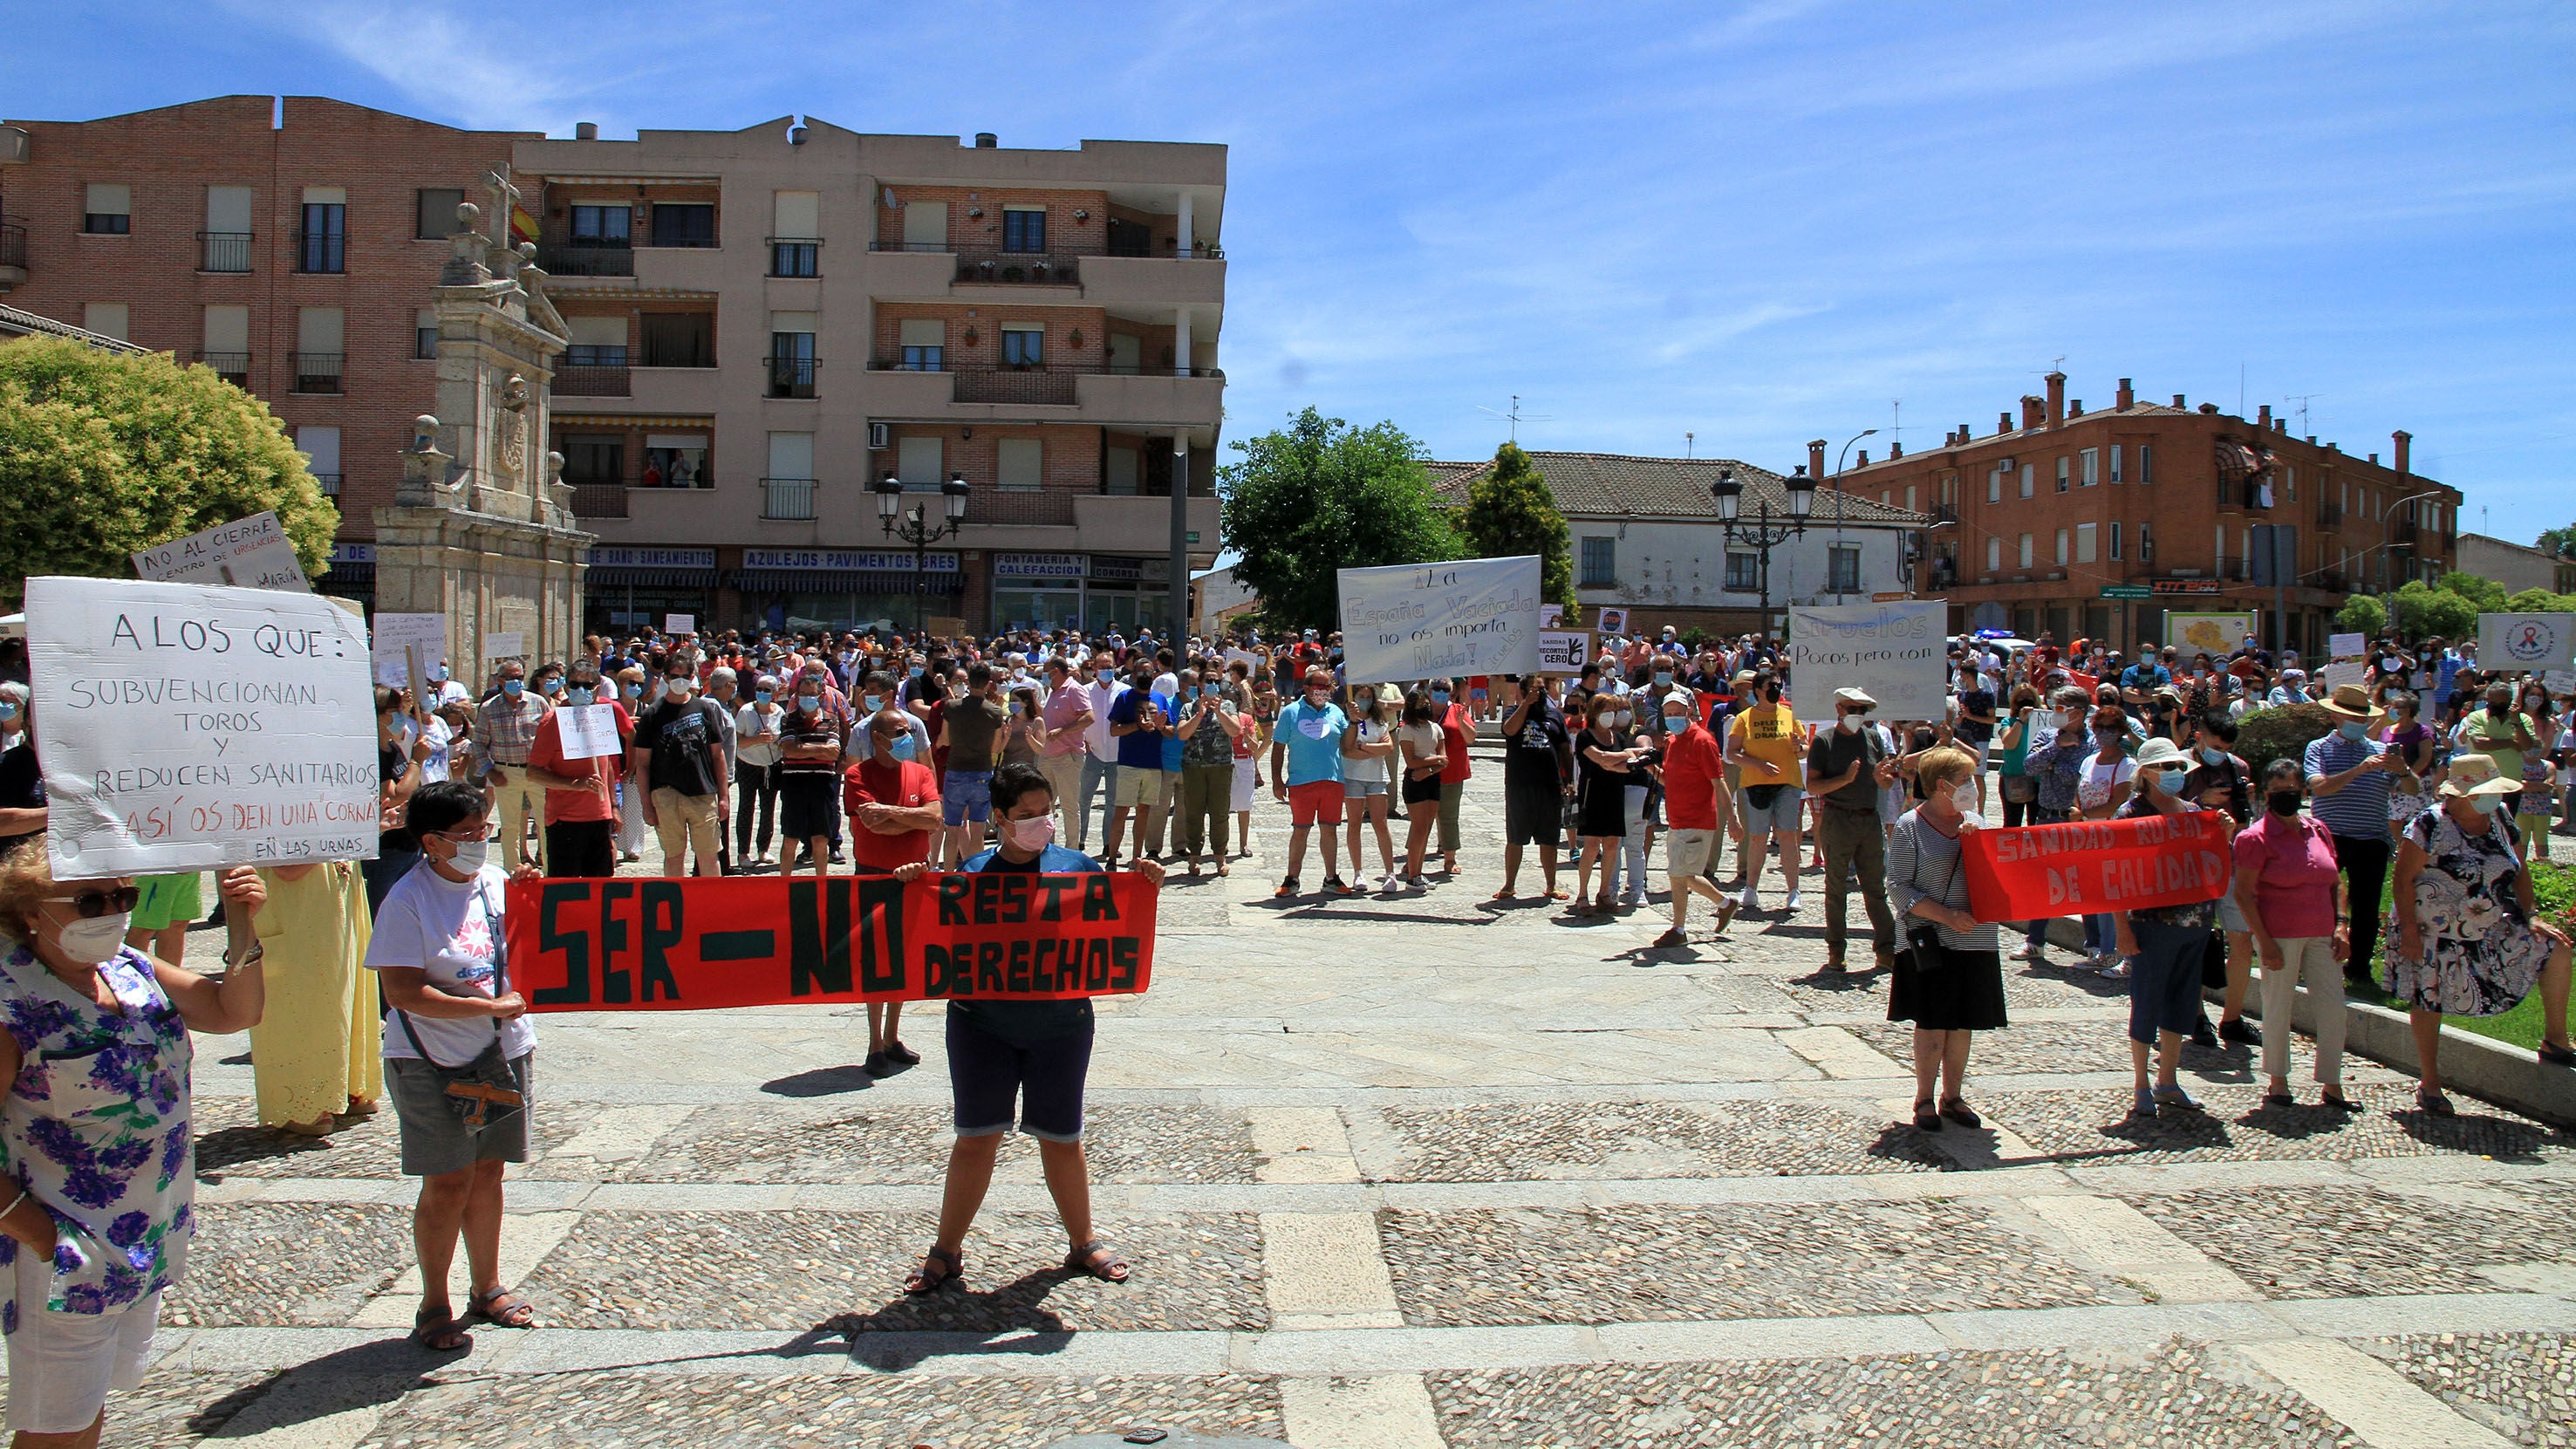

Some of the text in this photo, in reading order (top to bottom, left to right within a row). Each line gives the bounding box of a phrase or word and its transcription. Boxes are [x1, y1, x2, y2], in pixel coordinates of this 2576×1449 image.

[145, 518, 272, 571] NO AL CIERRE
[157, 534, 281, 582] CENTRO DE URGENCIAS
[350, 546, 366, 559] DE
[590, 550, 601, 564] DE
[640, 550, 713, 565] SANEAMIENTOS
[747, 551, 818, 567] AZULEJOS
[828, 552, 912, 568] PAVIMENTOS
[996, 554, 1083, 565] FONTANERIA Y
[999, 564, 1083, 576] CALEFACCION
[1346, 588, 1534, 631] España Vaciada
[1792, 606, 1927, 639] Ciruelos
[112, 613, 141, 651] A
[154, 615, 231, 653] LOS
[1379, 619, 1507, 646] no os importa
[1413, 642, 1478, 672] Nada!
[1544, 654, 1568, 664] CERO
[1794, 644, 1931, 667] Pocos pero con
[68, 677, 318, 708] SUBVENCIONAN
[174, 711, 263, 732] TOROS
[213, 737, 229, 757] Y
[95, 764, 231, 795] REDUCEN
[189, 798, 223, 832] OS
[232, 802, 272, 830] DEN
[281, 800, 319, 828] UNA
[285, 838, 311, 855] LAS
[1996, 816, 2211, 864] SANIDAD RURAL
[2047, 850, 2224, 906] DE CALIDAD
[532, 880, 683, 1006] SER
[789, 878, 906, 996] NO
[939, 875, 1120, 926] RESTA
[924, 936, 1140, 999] DERECHOS
